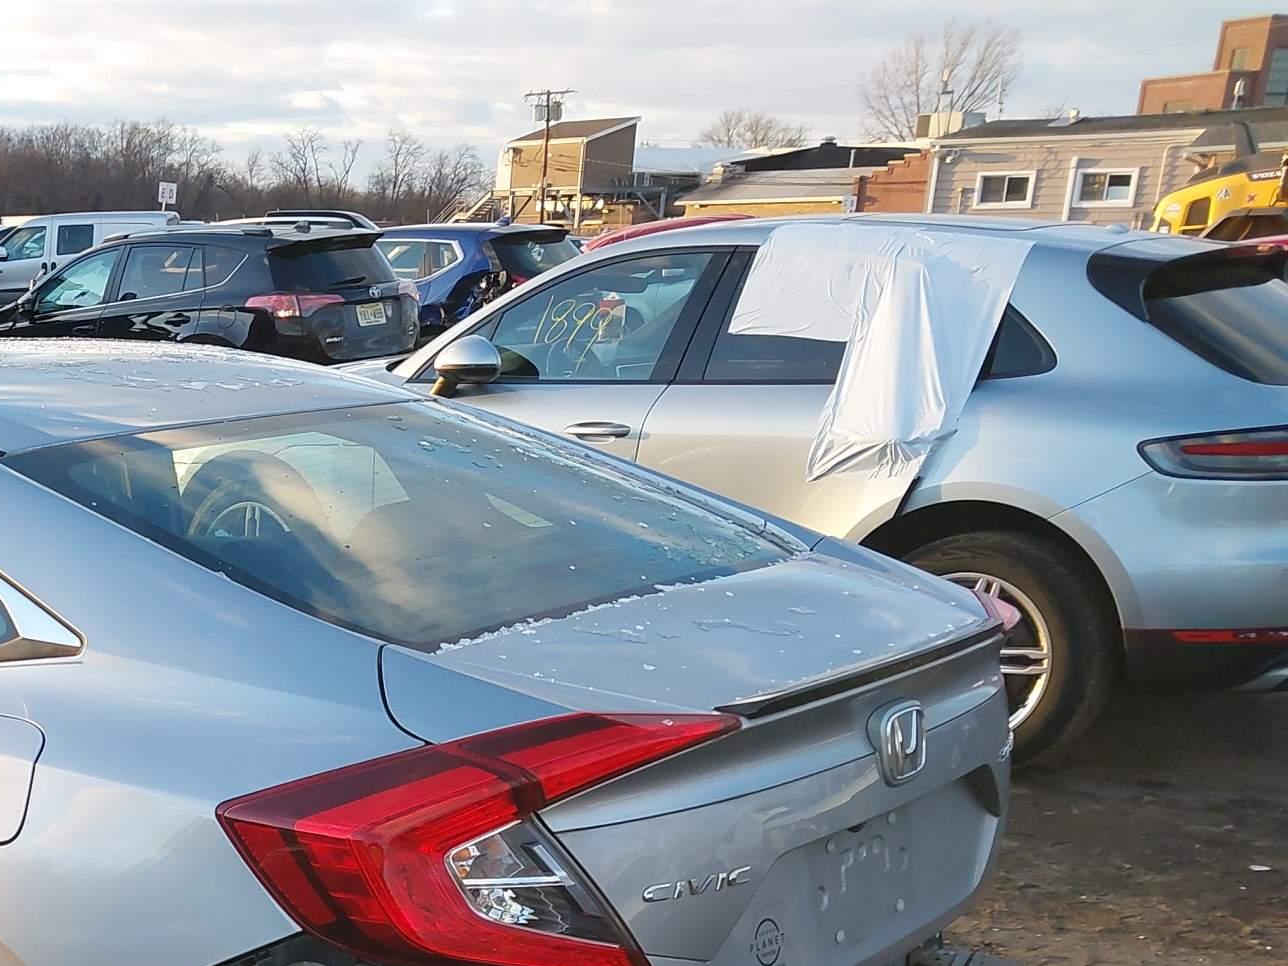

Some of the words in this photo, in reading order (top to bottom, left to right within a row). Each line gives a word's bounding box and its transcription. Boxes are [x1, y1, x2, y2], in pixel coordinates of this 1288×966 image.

[534, 294, 612, 374] 1899
[642, 865, 752, 903] CIVIC
[749, 932, 785, 954] PLANET
